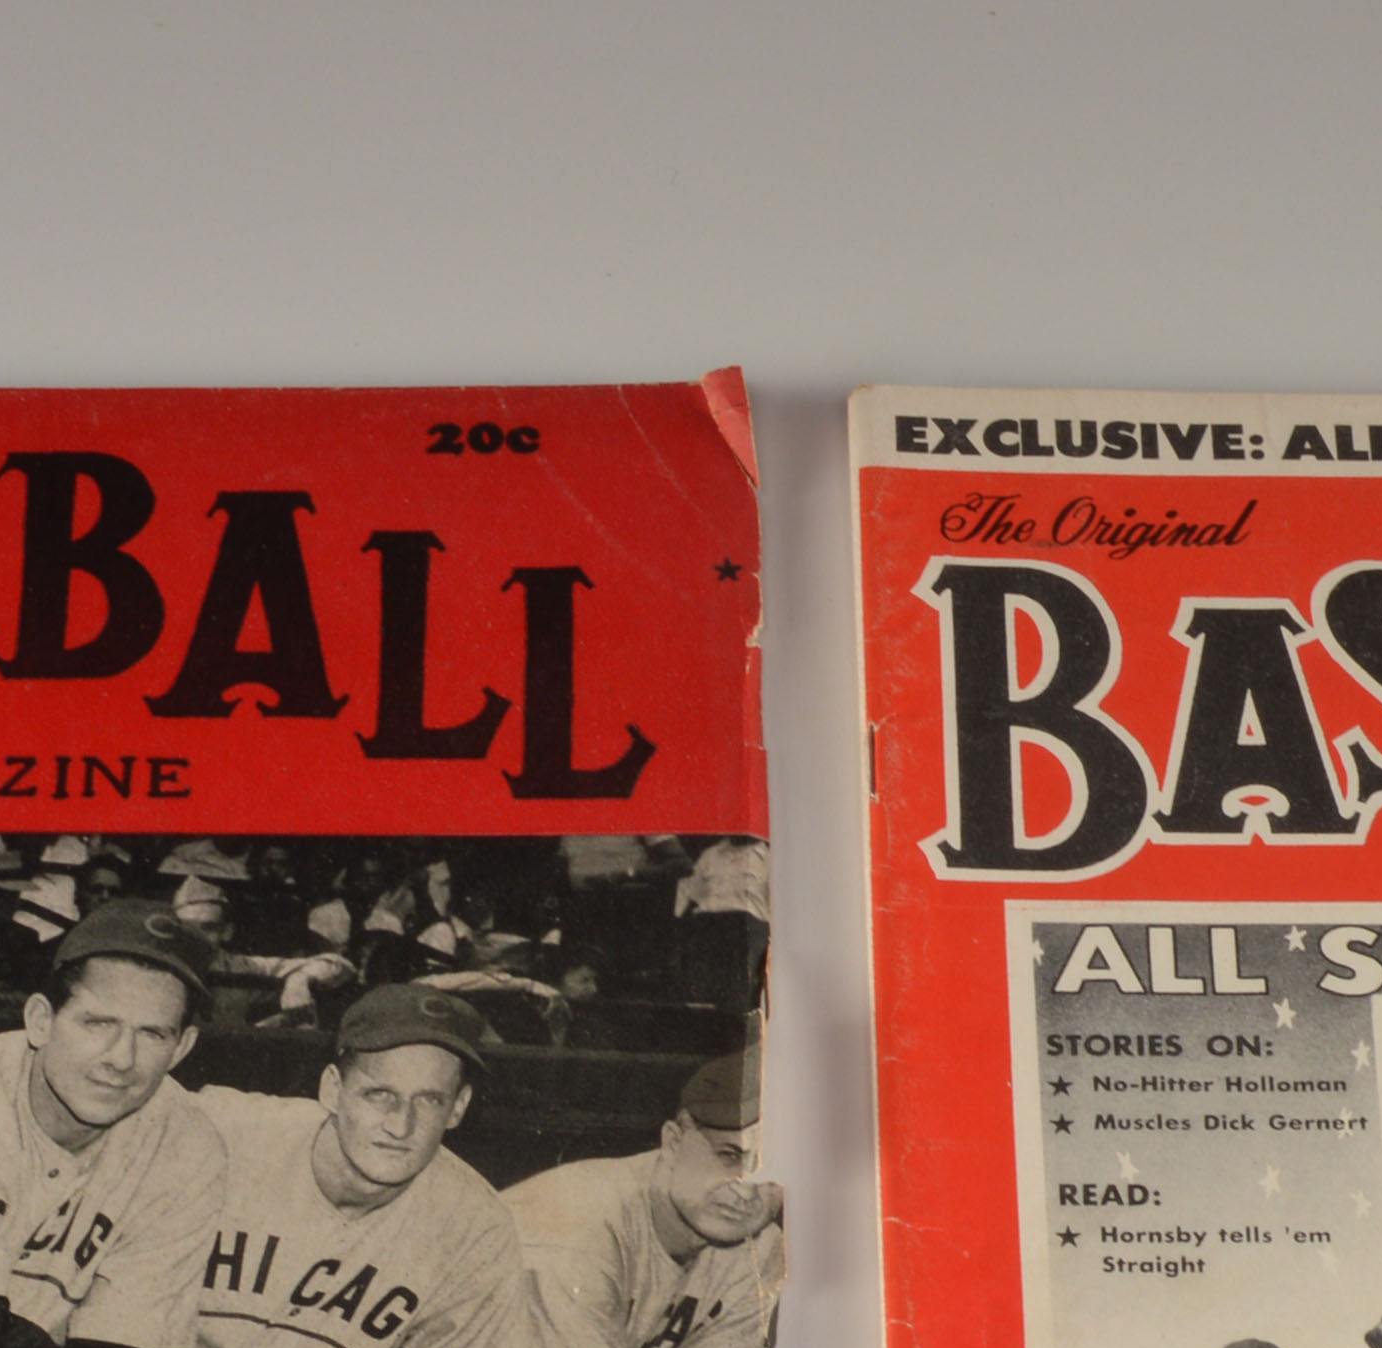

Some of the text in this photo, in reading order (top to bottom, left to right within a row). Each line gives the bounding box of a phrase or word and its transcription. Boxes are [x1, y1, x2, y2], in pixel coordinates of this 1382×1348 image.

[426, 421, 541, 456] 20c
[895, 415, 1266, 461] EXCLUSIVE:
[939, 492, 1259, 560] The Original
[1052, 924, 1269, 996] ALL
[1046, 1034, 1274, 1056] STORIES ON:
[1093, 1076, 1348, 1093] No-Hitter Holloman
[1094, 1115, 1368, 1132] Muscles Dick Gernert
[1058, 1184, 1162, 1206] READ:
[1100, 1227, 1331, 1247] Hornsby tells 'em
[1102, 1256, 1206, 1277] Straight
